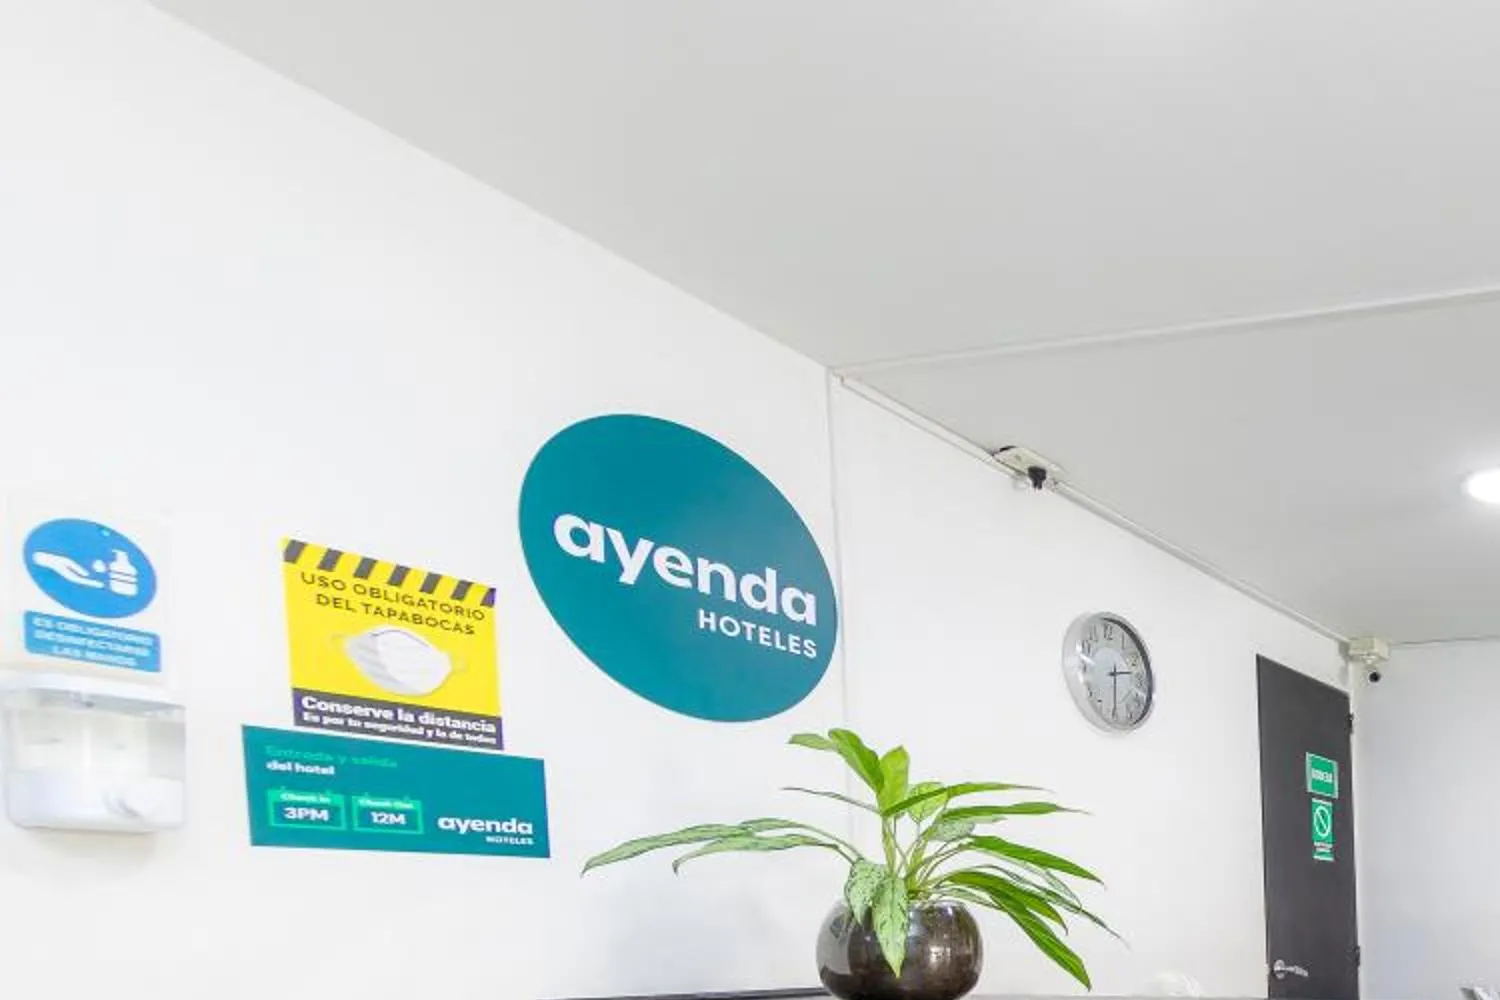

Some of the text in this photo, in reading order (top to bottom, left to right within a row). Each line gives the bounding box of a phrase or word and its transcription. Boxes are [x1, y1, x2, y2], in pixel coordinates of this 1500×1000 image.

[553, 513, 817, 626] ayenda
[301, 571, 486, 621] USO OBLIGATORIO
[316, 593, 476, 635] DEL TAPABOCAS
[699, 609, 818, 659] HOTELES
[301, 695, 497, 734] Conserve la distancia
[321, 715, 345, 728] por
[363, 720, 424, 736] seguridad
[427, 726, 434, 738] y
[436, 727, 447, 738] la
[264, 745, 334, 762] Entrada
[265, 759, 335, 776] del hotel
[283, 807, 329, 822] 3PM
[370, 811, 407, 825] 12M
[437, 817, 533, 835] ayenda
[485, 835, 535, 846] HOTELES
